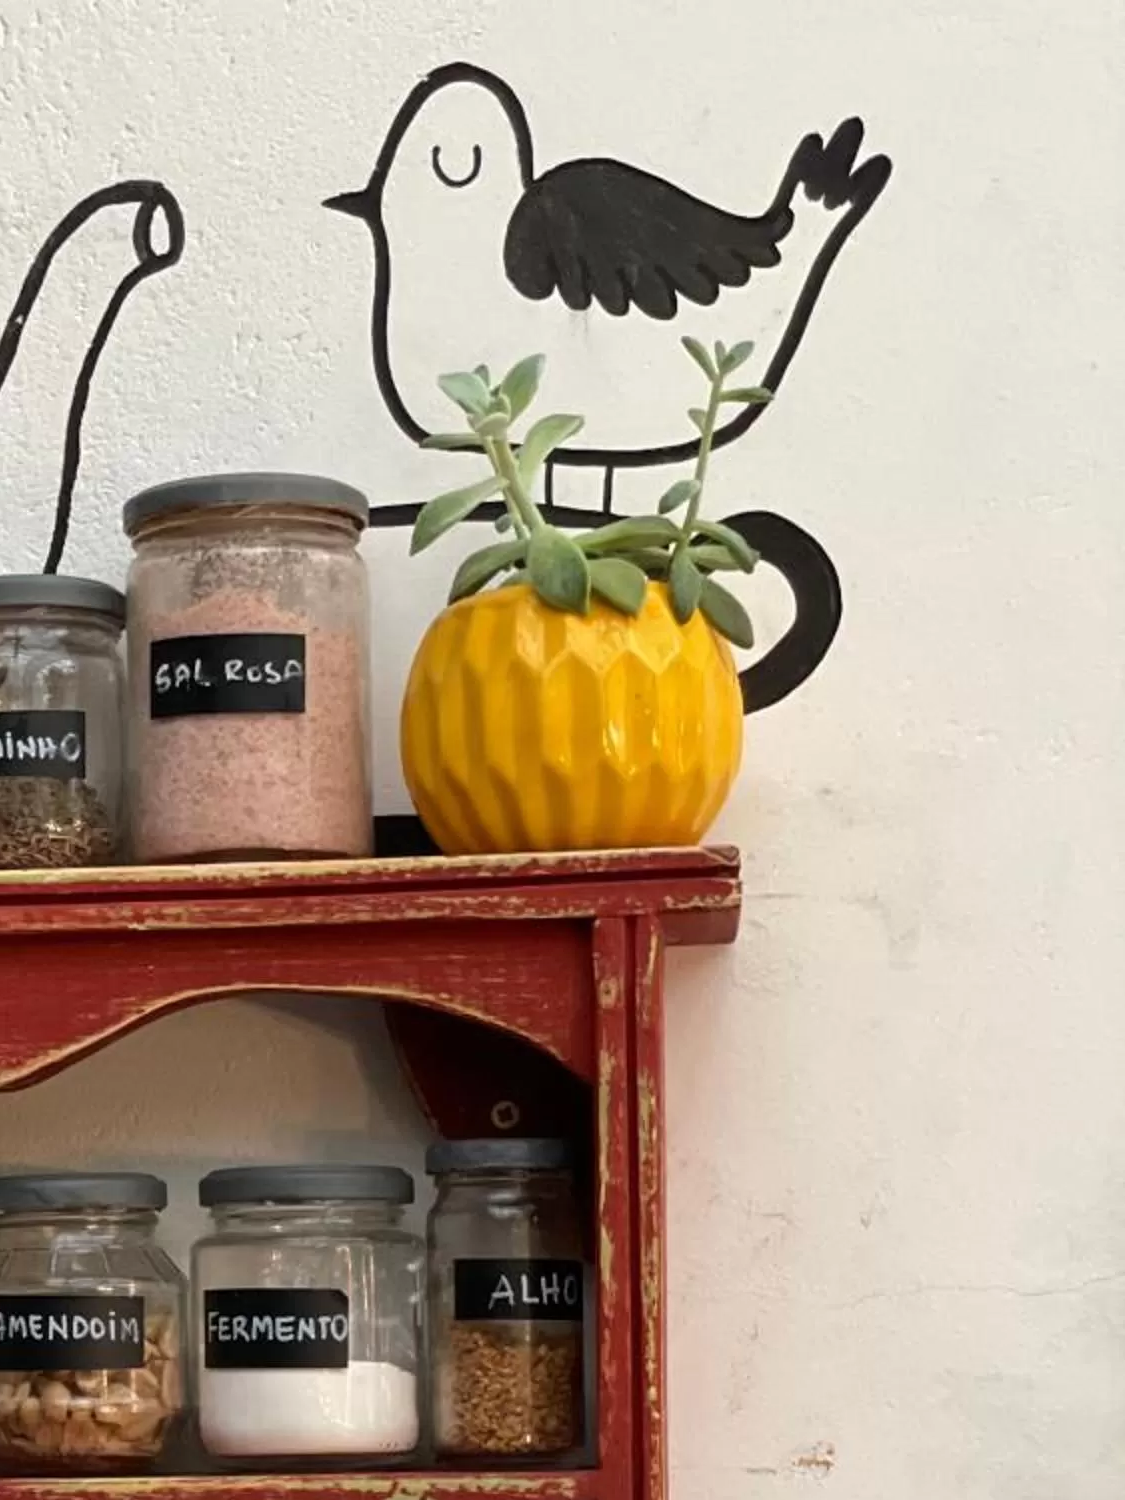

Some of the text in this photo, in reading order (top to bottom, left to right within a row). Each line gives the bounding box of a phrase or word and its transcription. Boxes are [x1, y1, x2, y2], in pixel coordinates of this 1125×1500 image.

[154, 658, 303, 694] SAL ROSA
[488, 1272, 578, 1310] ALHO
[208, 1311, 349, 1343] FERMENTO
